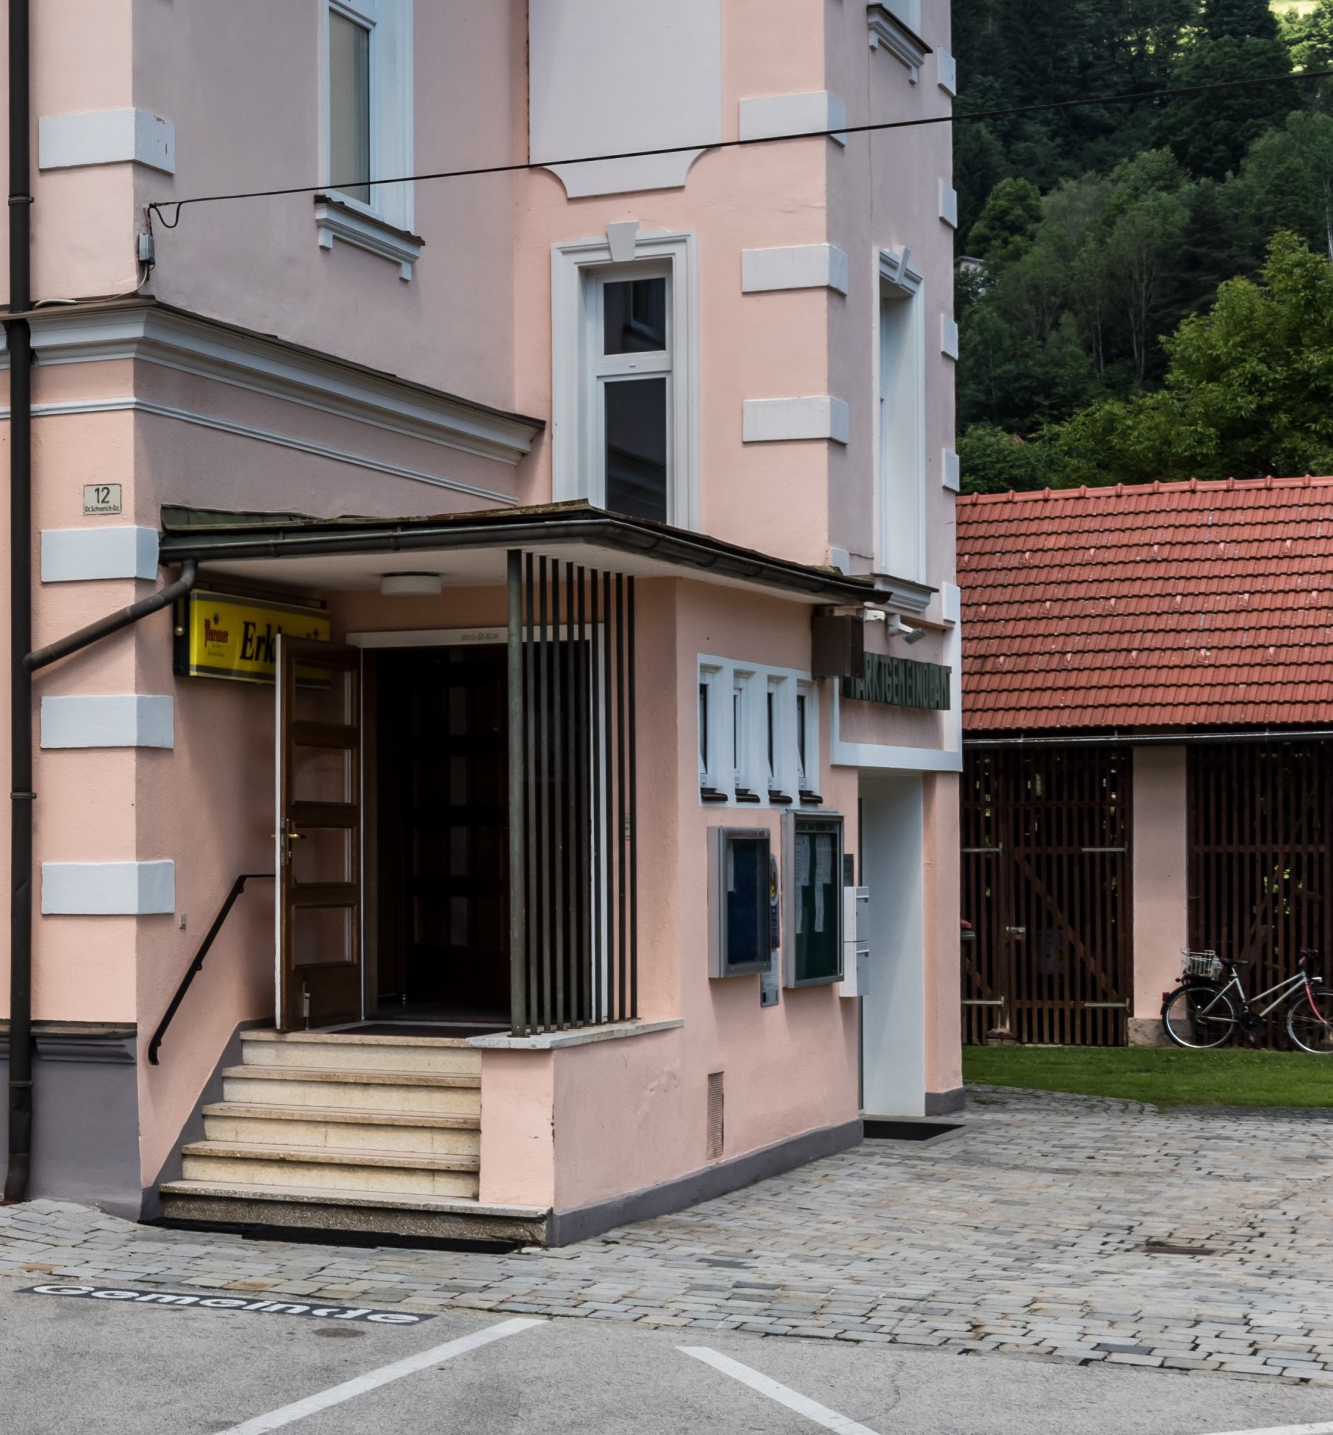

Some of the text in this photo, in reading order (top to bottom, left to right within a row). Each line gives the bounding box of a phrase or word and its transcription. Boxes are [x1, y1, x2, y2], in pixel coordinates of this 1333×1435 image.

[94, 486, 110, 504] 12
[239, 620, 282, 664] Erk
[851, 652, 952, 710] RKTGEMEINDEAMT
[33, 1284, 421, 1323] Gemeinde
